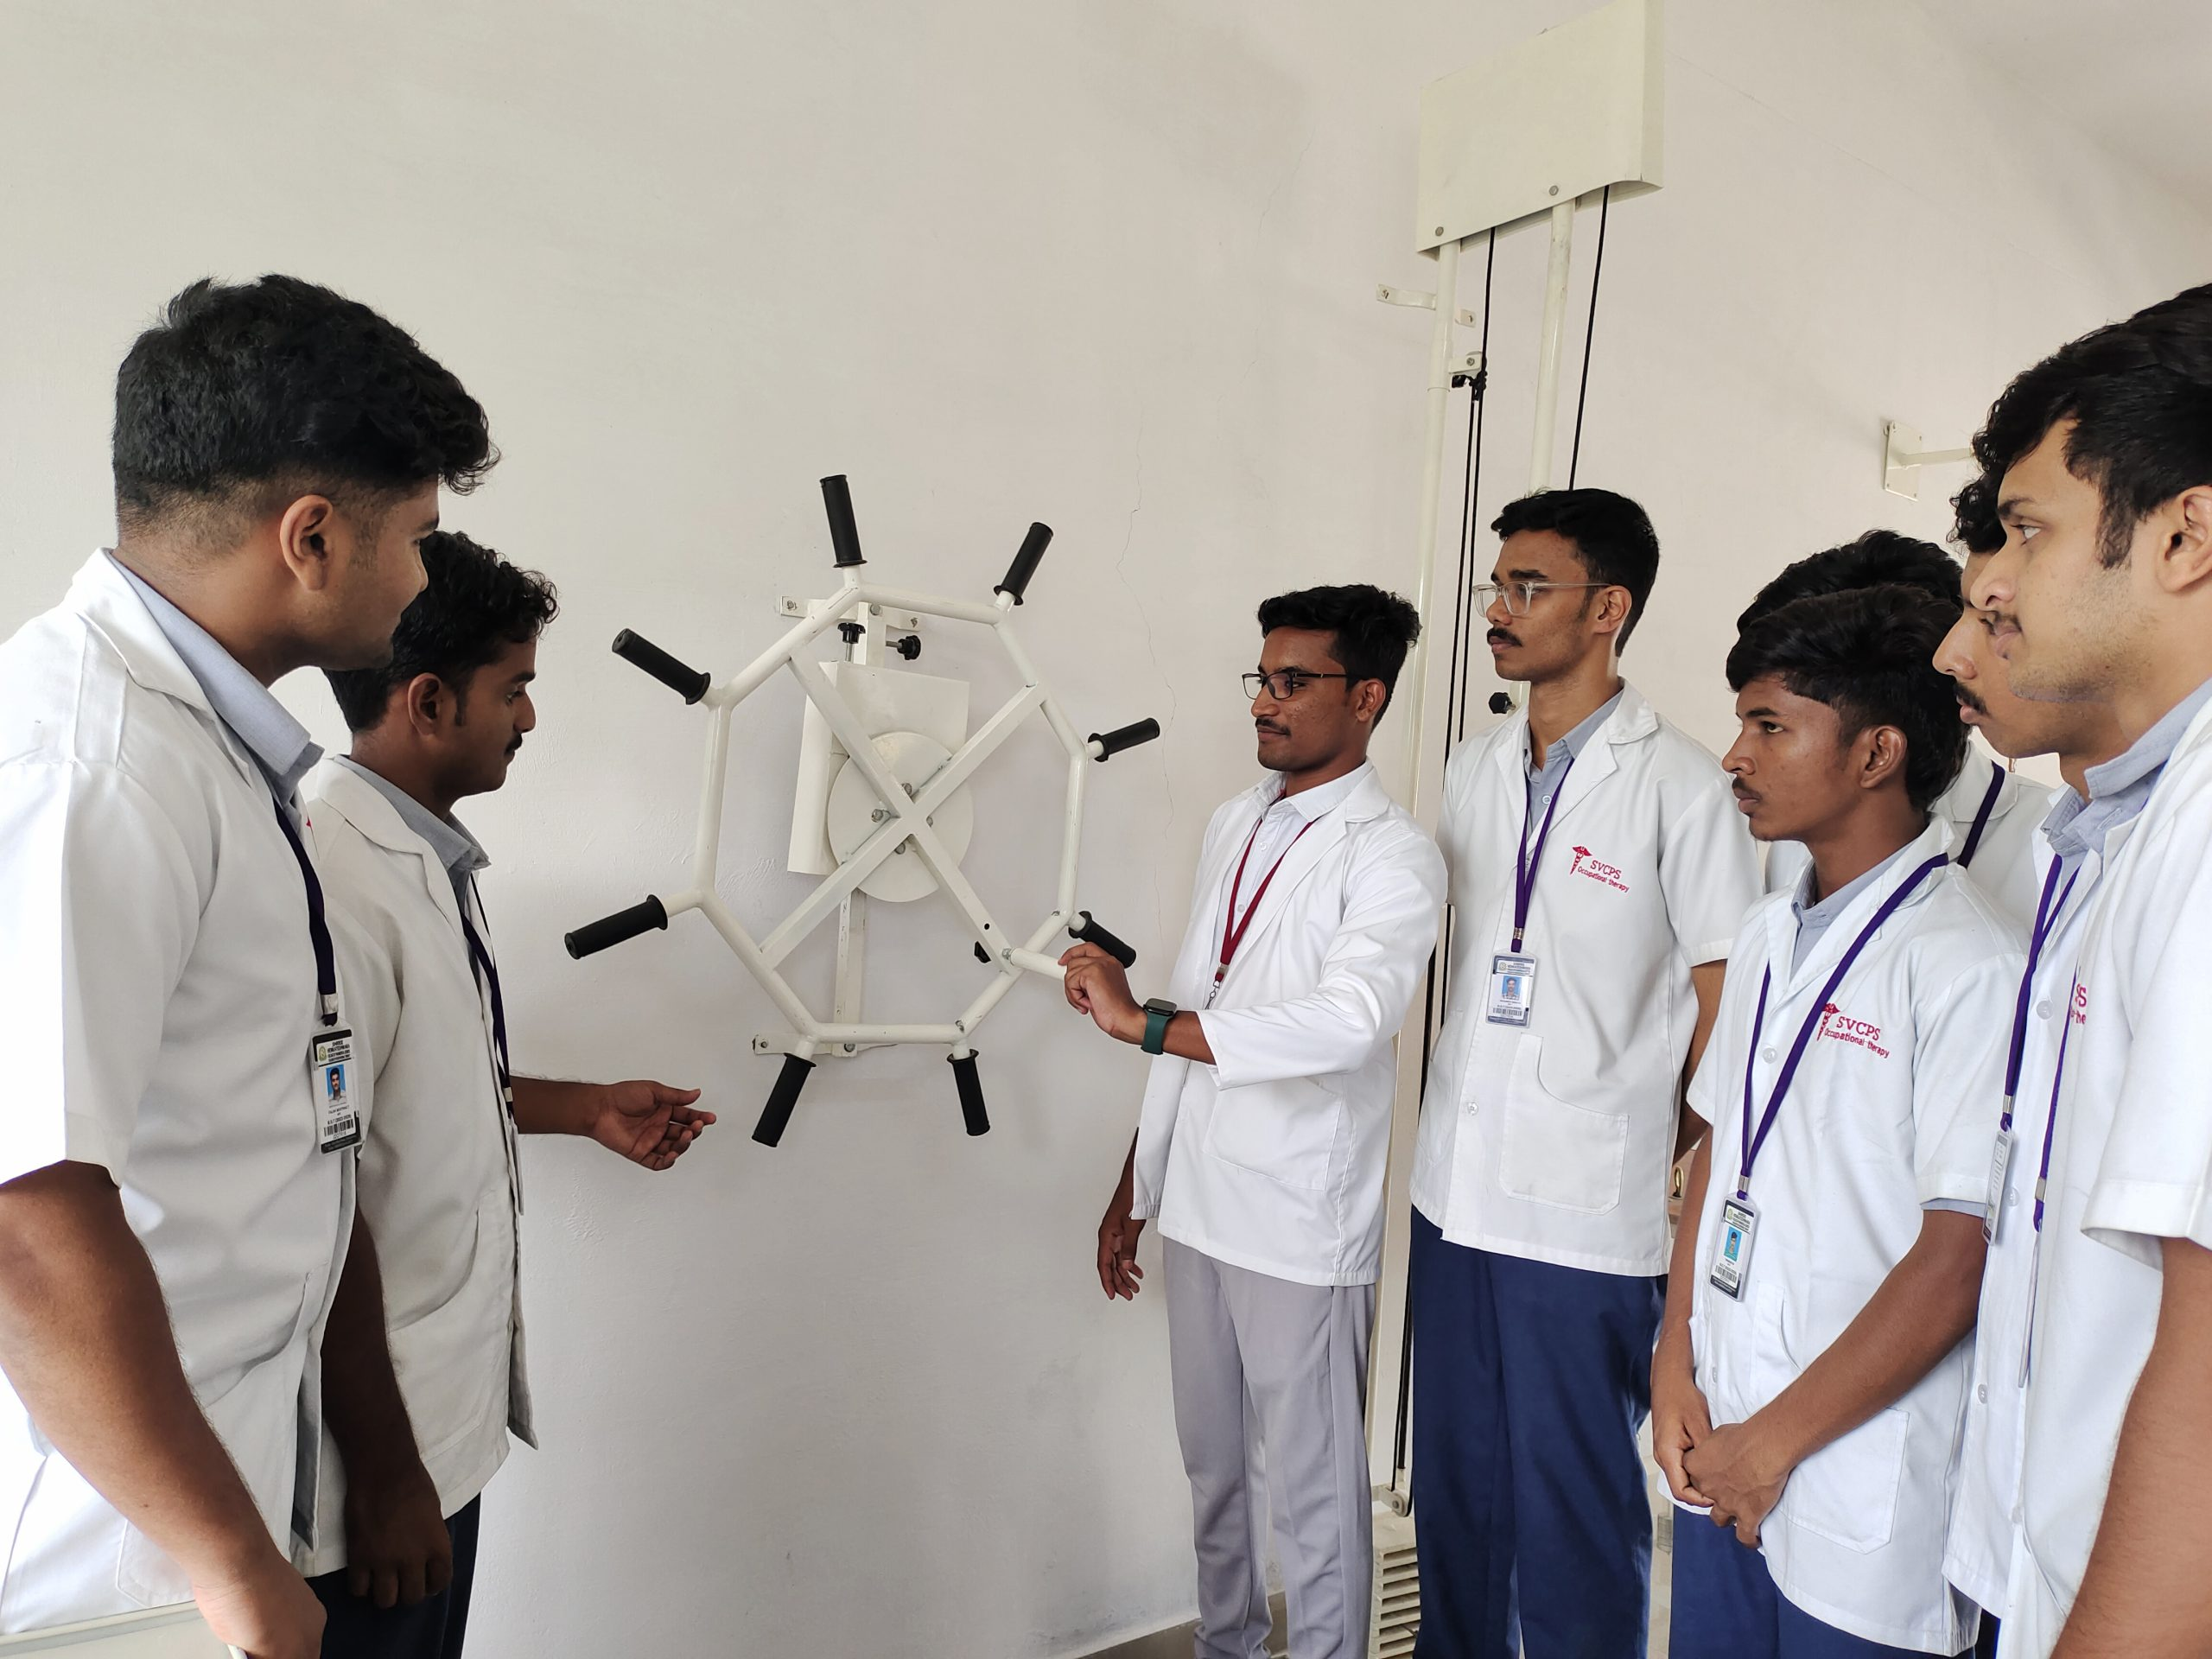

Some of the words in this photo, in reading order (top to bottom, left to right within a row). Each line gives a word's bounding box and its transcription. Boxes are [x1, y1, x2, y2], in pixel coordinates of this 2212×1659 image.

[1577, 866, 1607, 882] Occupational
[1608, 878, 1630, 893] therapy
[1590, 859, 1622, 880] SVCPS
[1836, 1016, 1880, 1041] SVCPS
[1824, 1027, 1866, 1046] Occupational
[1867, 1040, 1890, 1059] therapy
